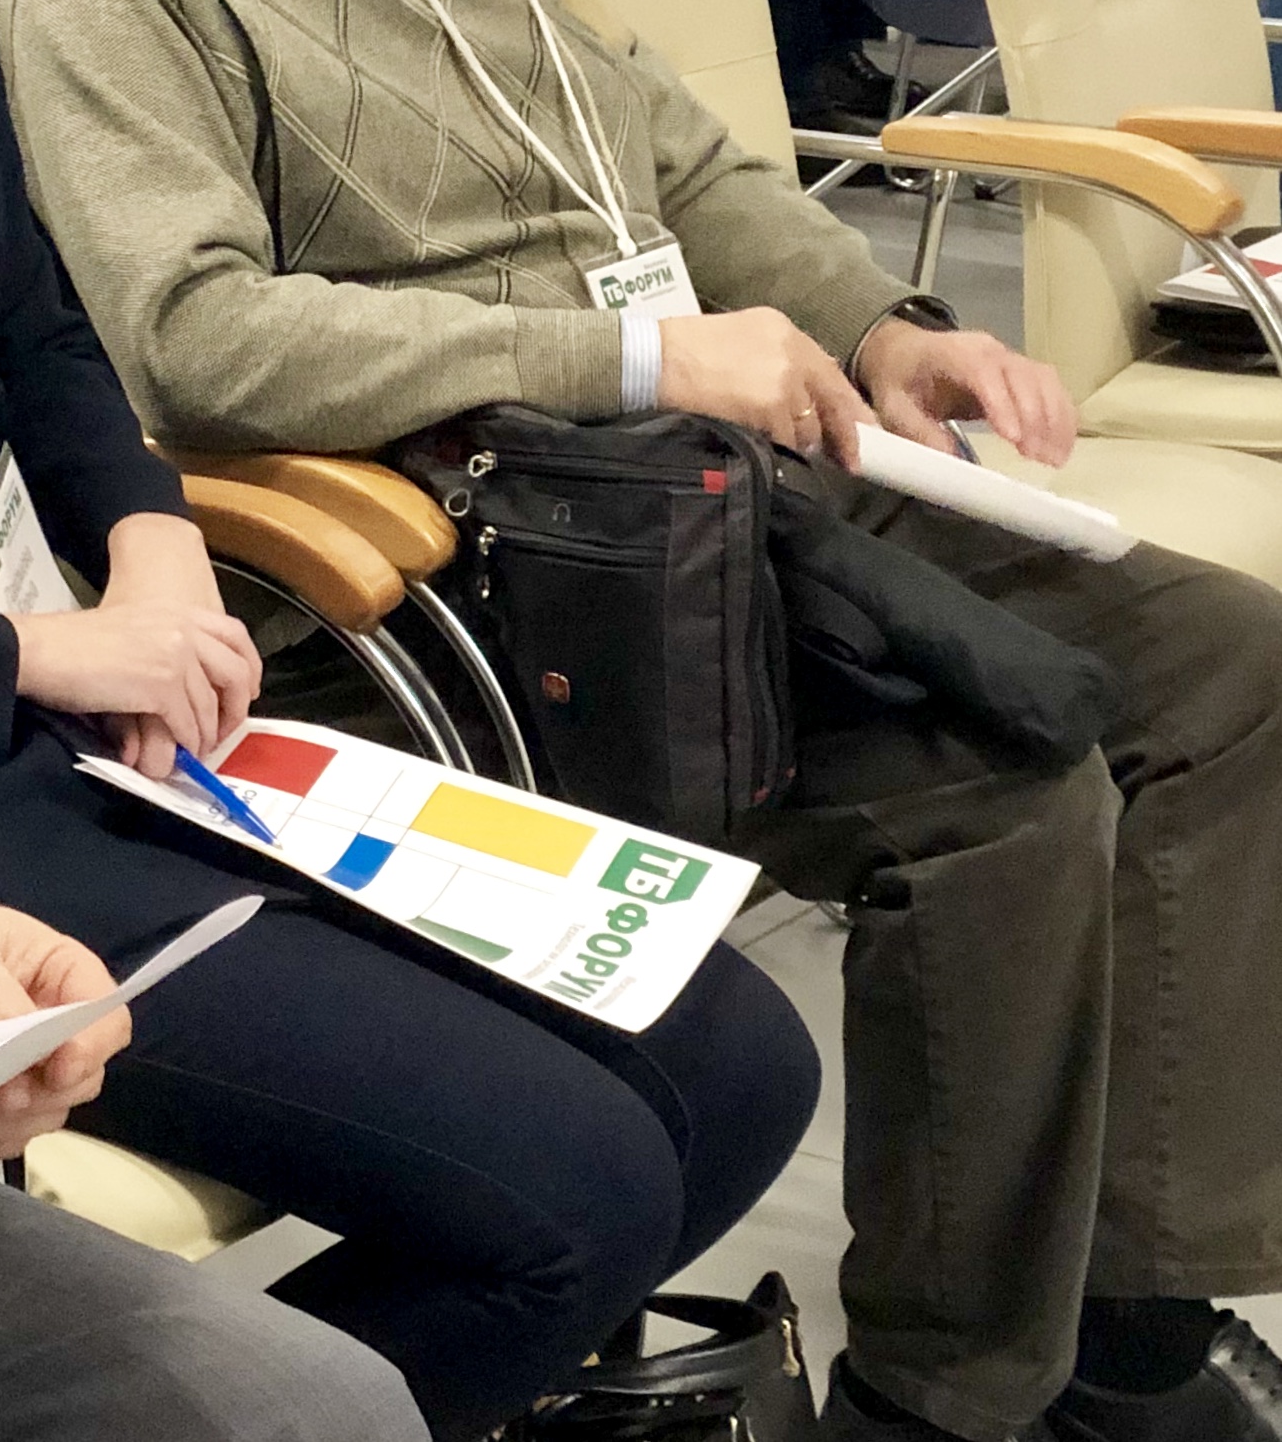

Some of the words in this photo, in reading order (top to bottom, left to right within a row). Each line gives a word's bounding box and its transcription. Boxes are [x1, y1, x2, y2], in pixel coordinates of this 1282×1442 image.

[625, 265, 675, 295] ФОРУМ
[624, 852, 690, 900] ТБ
[541, 902, 649, 1004] ФОРУМ
